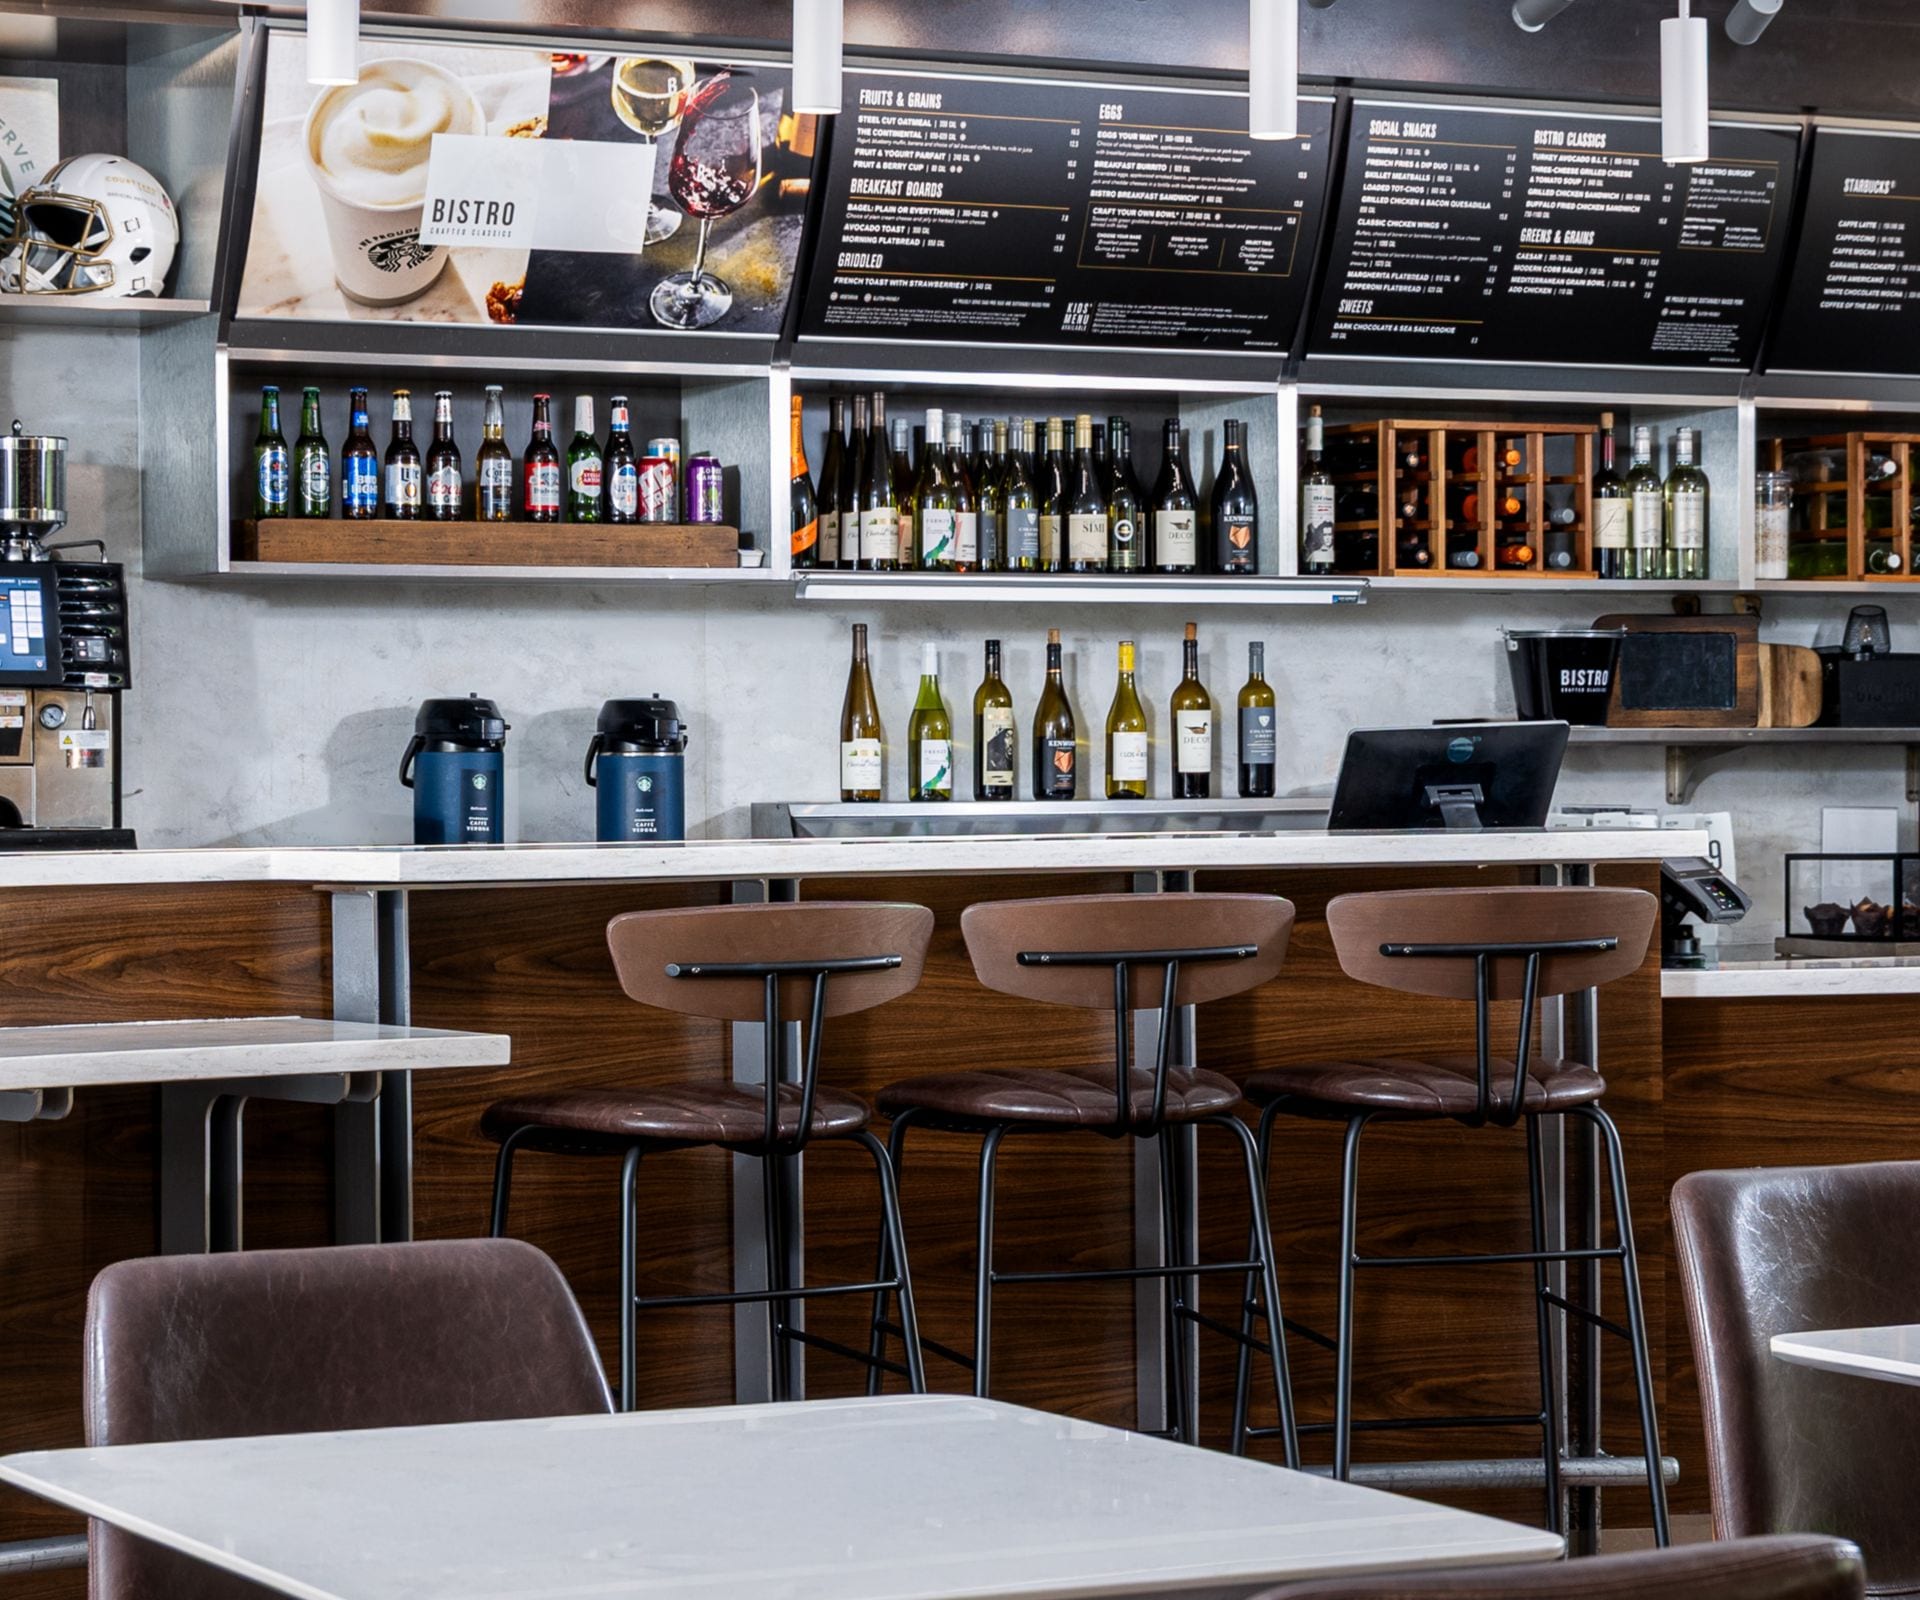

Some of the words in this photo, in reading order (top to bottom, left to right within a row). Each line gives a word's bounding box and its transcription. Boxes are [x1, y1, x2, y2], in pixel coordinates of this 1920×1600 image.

[860, 89, 893, 106] FRUITS
[896, 91, 904, 107] &
[907, 92, 942, 109] GRAINS
[1099, 104, 1123, 120] EGGS
[1369, 120, 1400, 136] SOCIAL
[1403, 121, 1437, 138] SNACKS
[1534, 130, 1564, 146] BISTRO
[1566, 132, 1606, 148] CLASSICS
[1094, 160, 1136, 169] BREAKFAST
[850, 178, 904, 196] BREAKFAST
[906, 181, 943, 198] BOARDS
[1090, 189, 1116, 198] BISTRO
[1117, 191, 1158, 200] BREAKFAST
[432, 198, 515, 226] BISTRO
[1093, 207, 1117, 216] CRAFT
[1117, 209, 1136, 217] YOUR
[843, 223, 880, 232] AVOCADO
[882, 225, 905, 233] TOAST
[1520, 228, 1552, 243] GREENS
[1553, 230, 1561, 244] &
[1563, 230, 1595, 245] GRAINS
[838, 252, 883, 268] GRIDDLED
[1338, 299, 1373, 314] SWEETS
[1063, 314, 1089, 325] MENU
[1561, 669, 1609, 686] BISTRO
